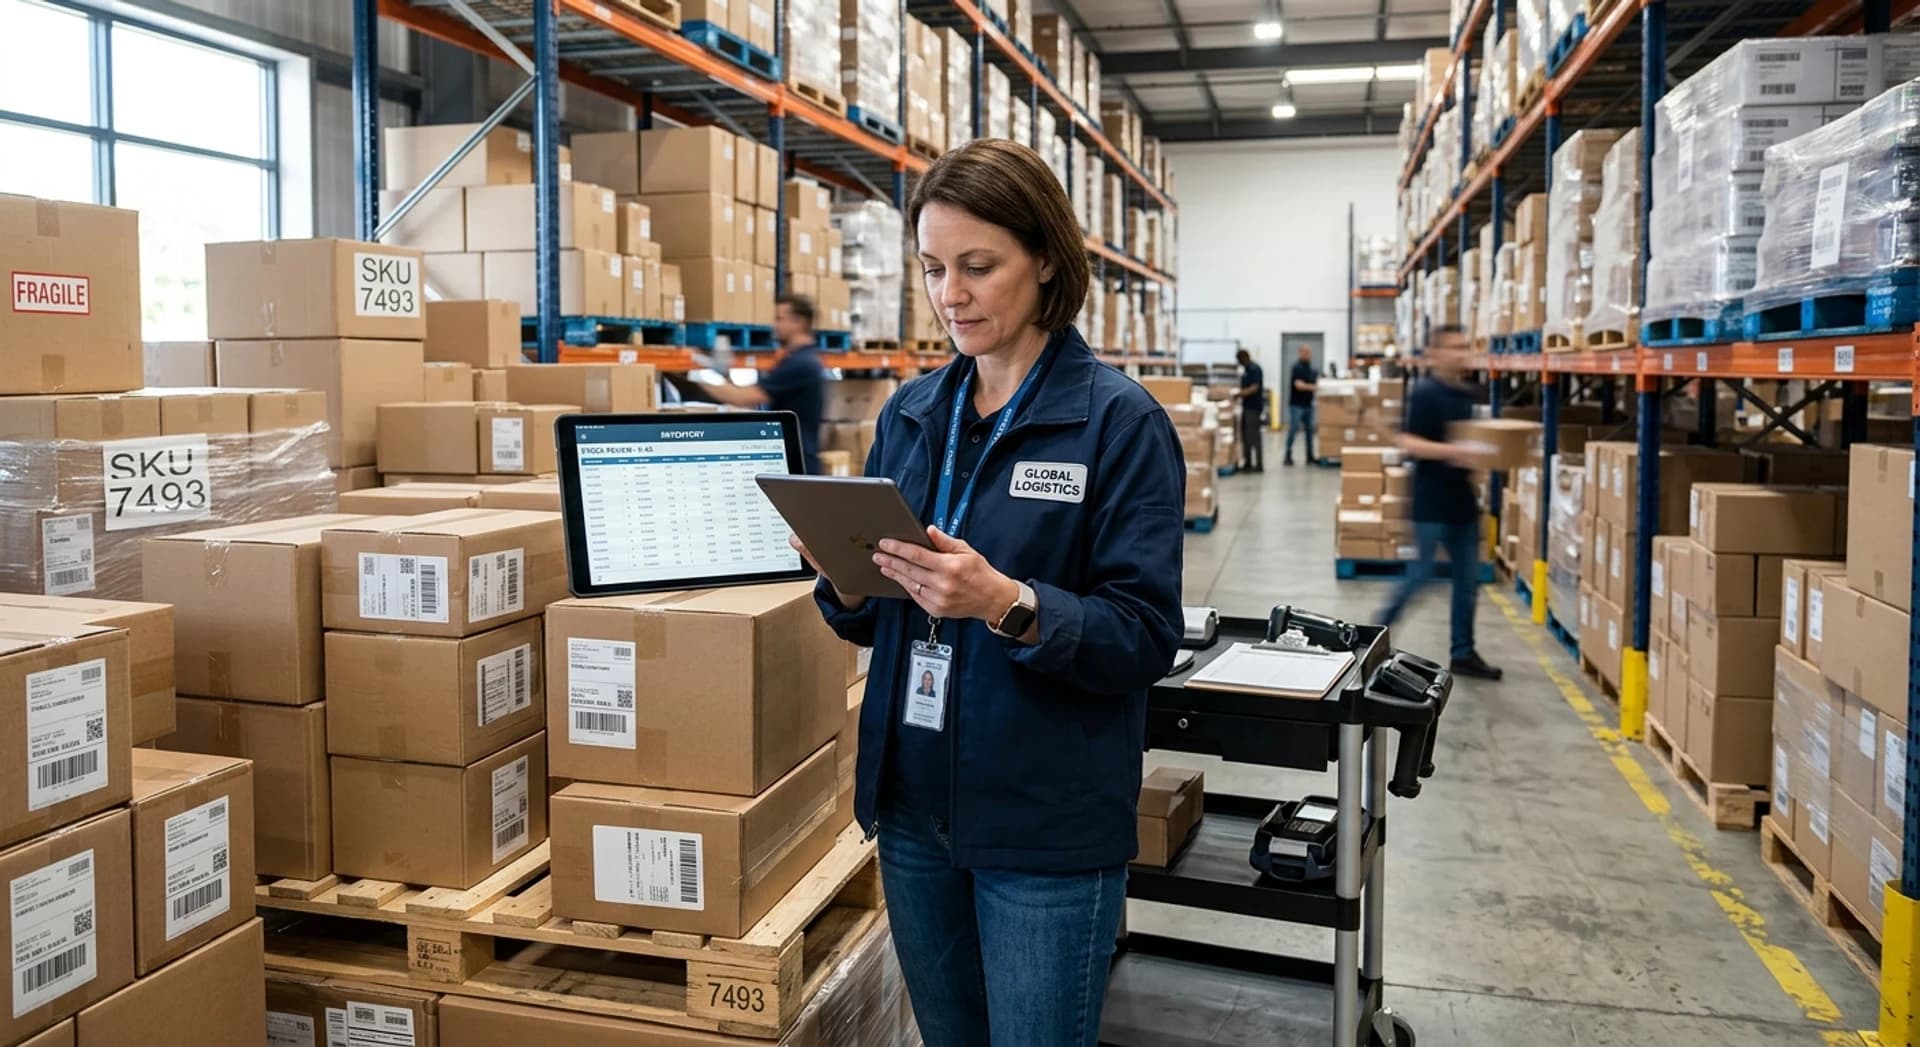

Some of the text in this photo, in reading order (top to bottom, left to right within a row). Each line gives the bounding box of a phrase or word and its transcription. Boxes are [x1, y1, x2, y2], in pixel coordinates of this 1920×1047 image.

[362, 258, 411, 284] SKU
[17, 281, 85, 305] FRAGILE
[361, 287, 414, 313] 7493
[111, 449, 192, 479] SKU
[1024, 468, 1073, 481] GLOBAL
[109, 480, 206, 517] 7493
[1014, 480, 1080, 496] LOGISTICS
[708, 982, 765, 1013] 7493
